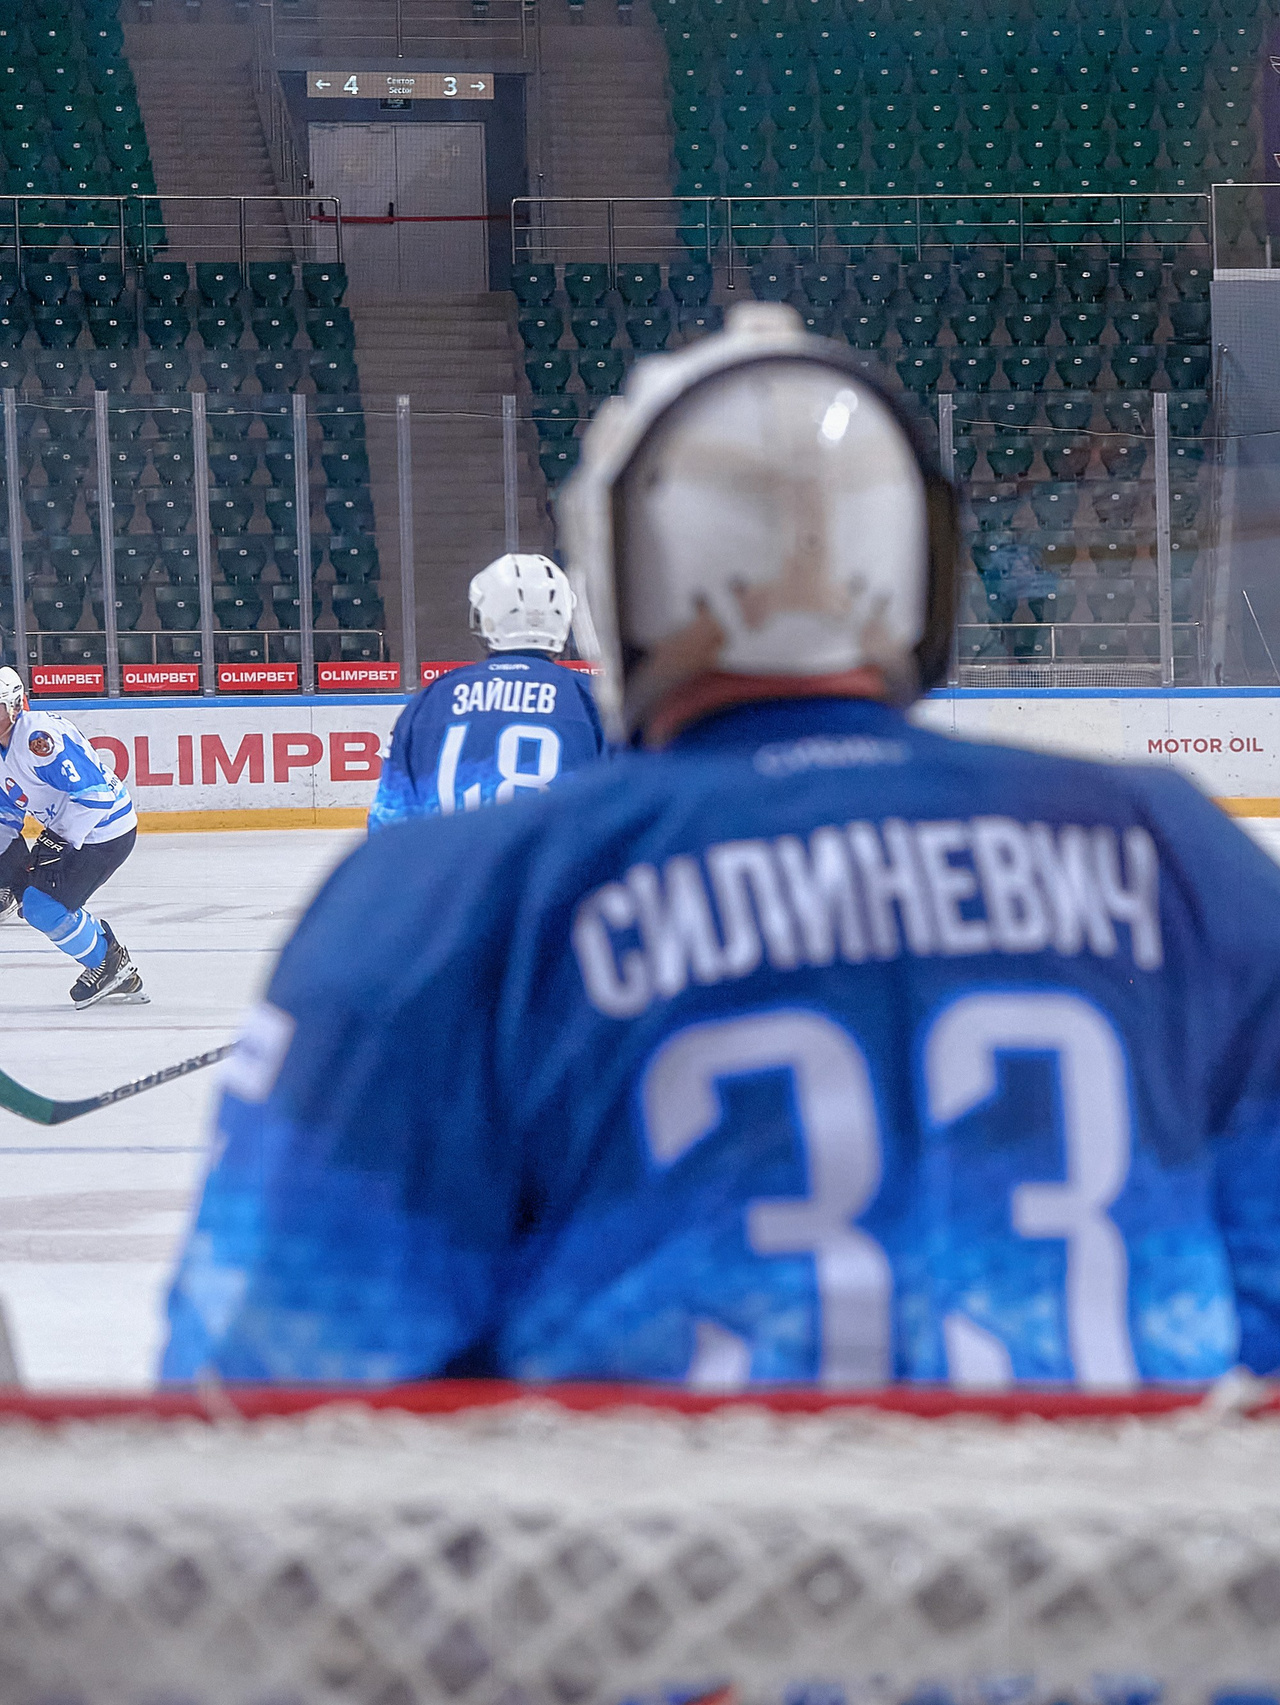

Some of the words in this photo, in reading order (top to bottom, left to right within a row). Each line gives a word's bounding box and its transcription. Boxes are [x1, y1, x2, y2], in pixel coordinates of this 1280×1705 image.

[343, 75, 359, 95] 4
[387, 77, 415, 85] Сектор
[443, 76, 458, 97] 3
[34, 674, 102, 685] OLIMPBET
[125, 672, 196, 684] OLIMPBET
[220, 671, 295, 683] OLIMPBET
[320, 670, 397, 681] OLIMPBET
[452, 677, 557, 715] ЗАЙЦЕВ
[1148, 738, 1222, 753] MOTOR
[1230, 737, 1264, 753] OIL
[86, 731, 382, 787] OLIMPB
[437, 724, 561, 815] 48
[572, 814, 1165, 1018] СИЛИНЕВИЧ
[642, 988, 1140, 1390] 33
